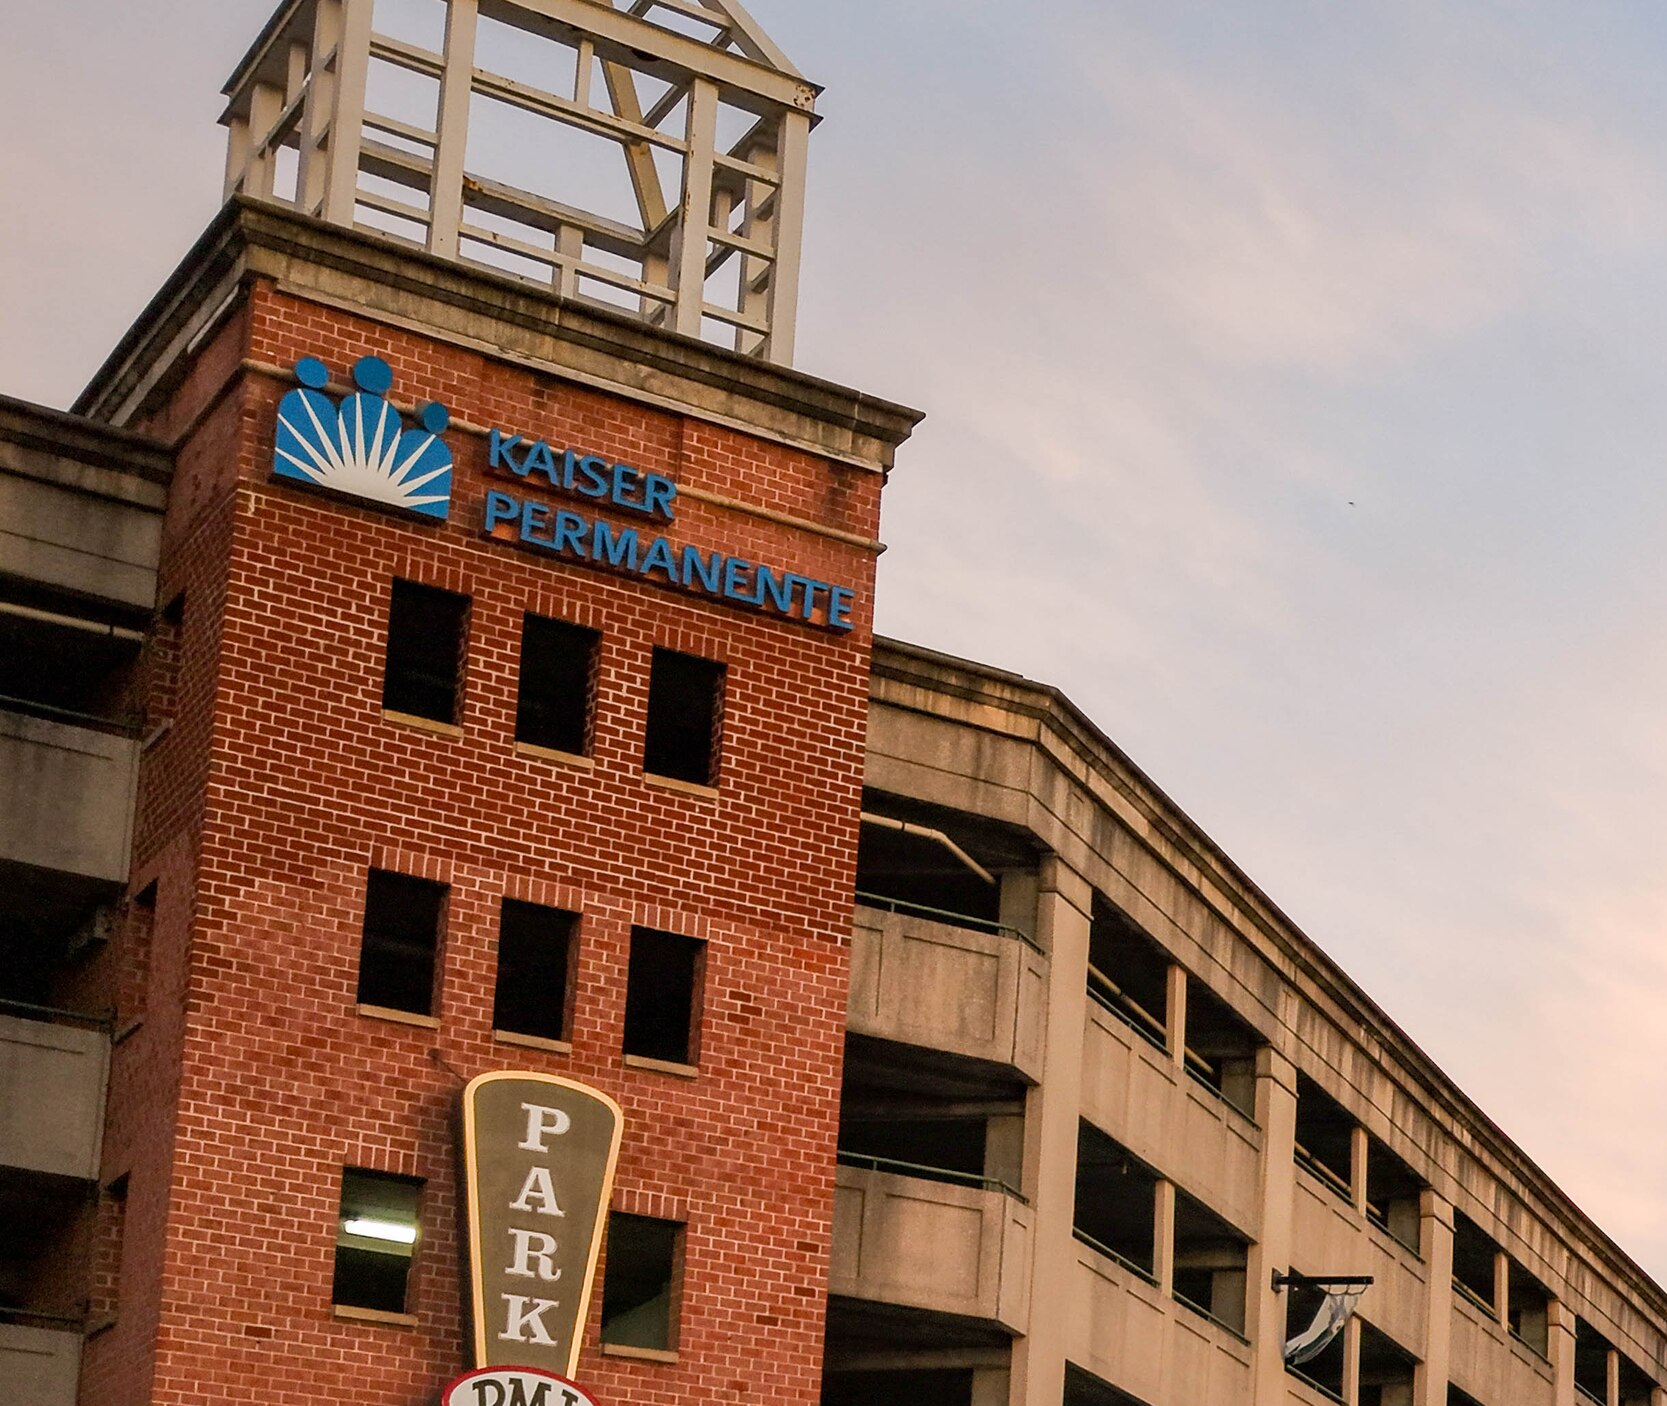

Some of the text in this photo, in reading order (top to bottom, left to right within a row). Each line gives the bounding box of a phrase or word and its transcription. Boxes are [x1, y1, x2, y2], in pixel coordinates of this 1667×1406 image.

[489, 428, 677, 520] KAISER
[485, 490, 855, 632] PERMANENTE
[497, 1102, 571, 1347] PARK
